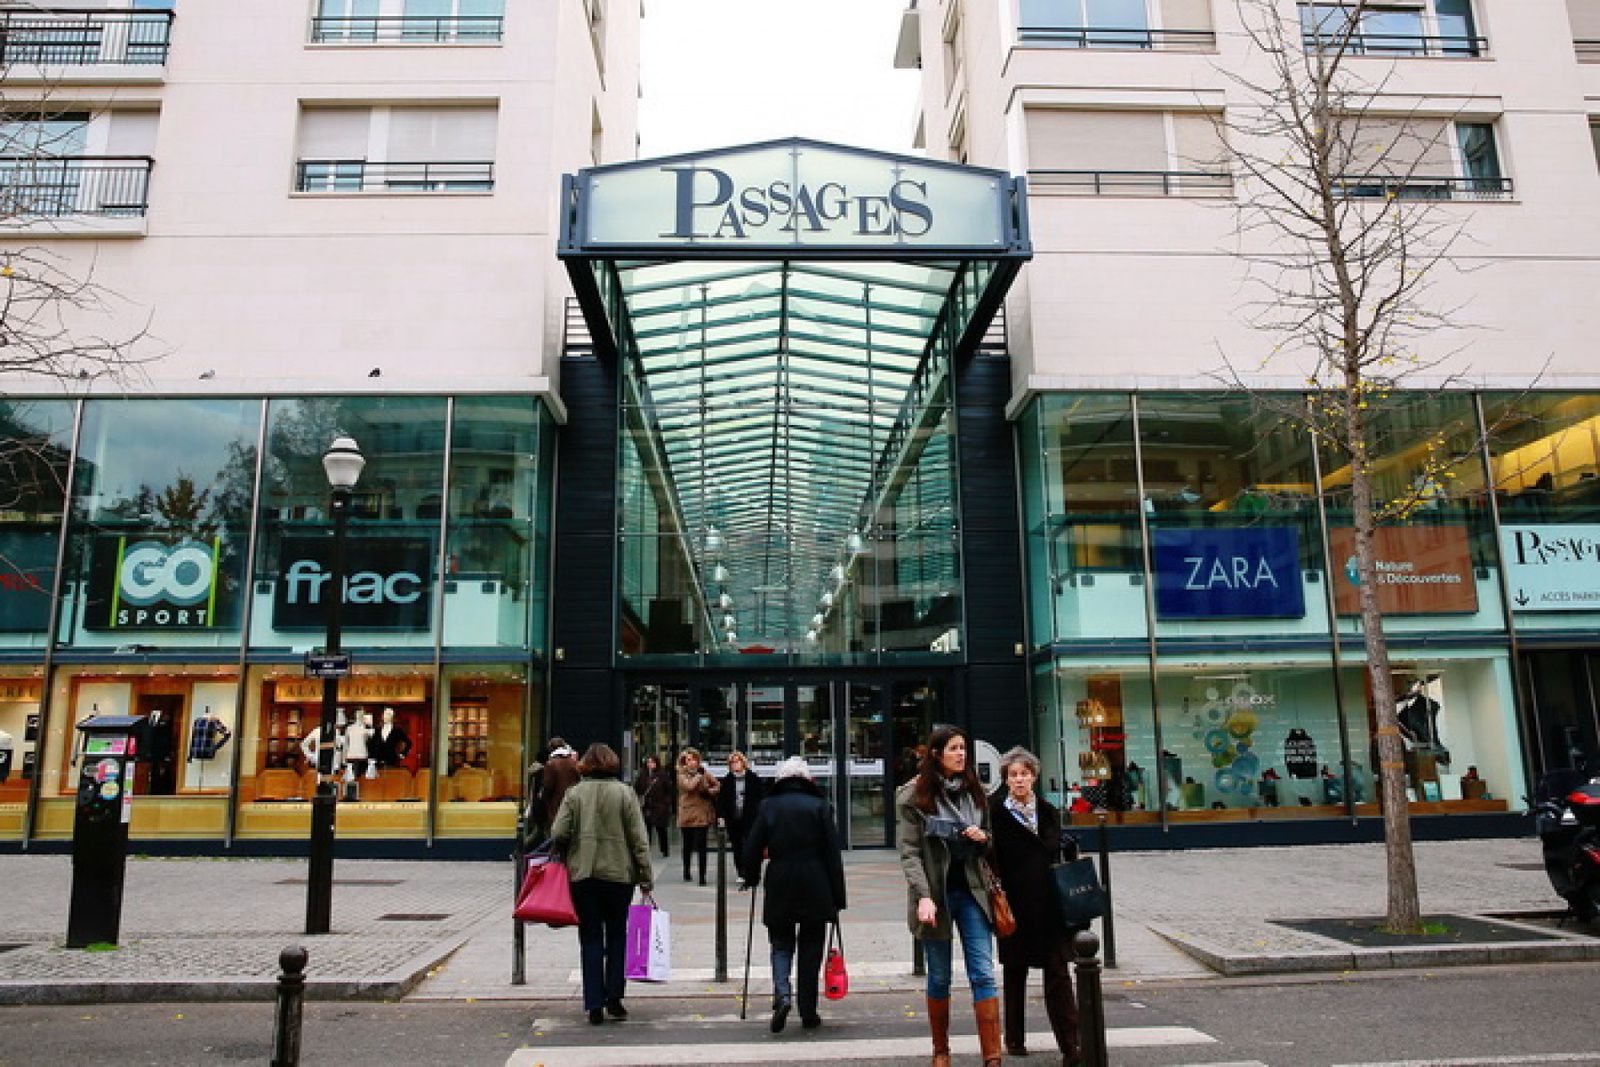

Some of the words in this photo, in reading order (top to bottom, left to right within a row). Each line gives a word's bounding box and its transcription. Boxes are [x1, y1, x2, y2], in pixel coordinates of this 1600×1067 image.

[659, 166, 934, 237] PASSAGES
[120, 547, 213, 599] GO
[1184, 555, 1279, 590] ZARA
[1375, 561, 1414, 572] Nature
[118, 609, 206, 625] SPORT
